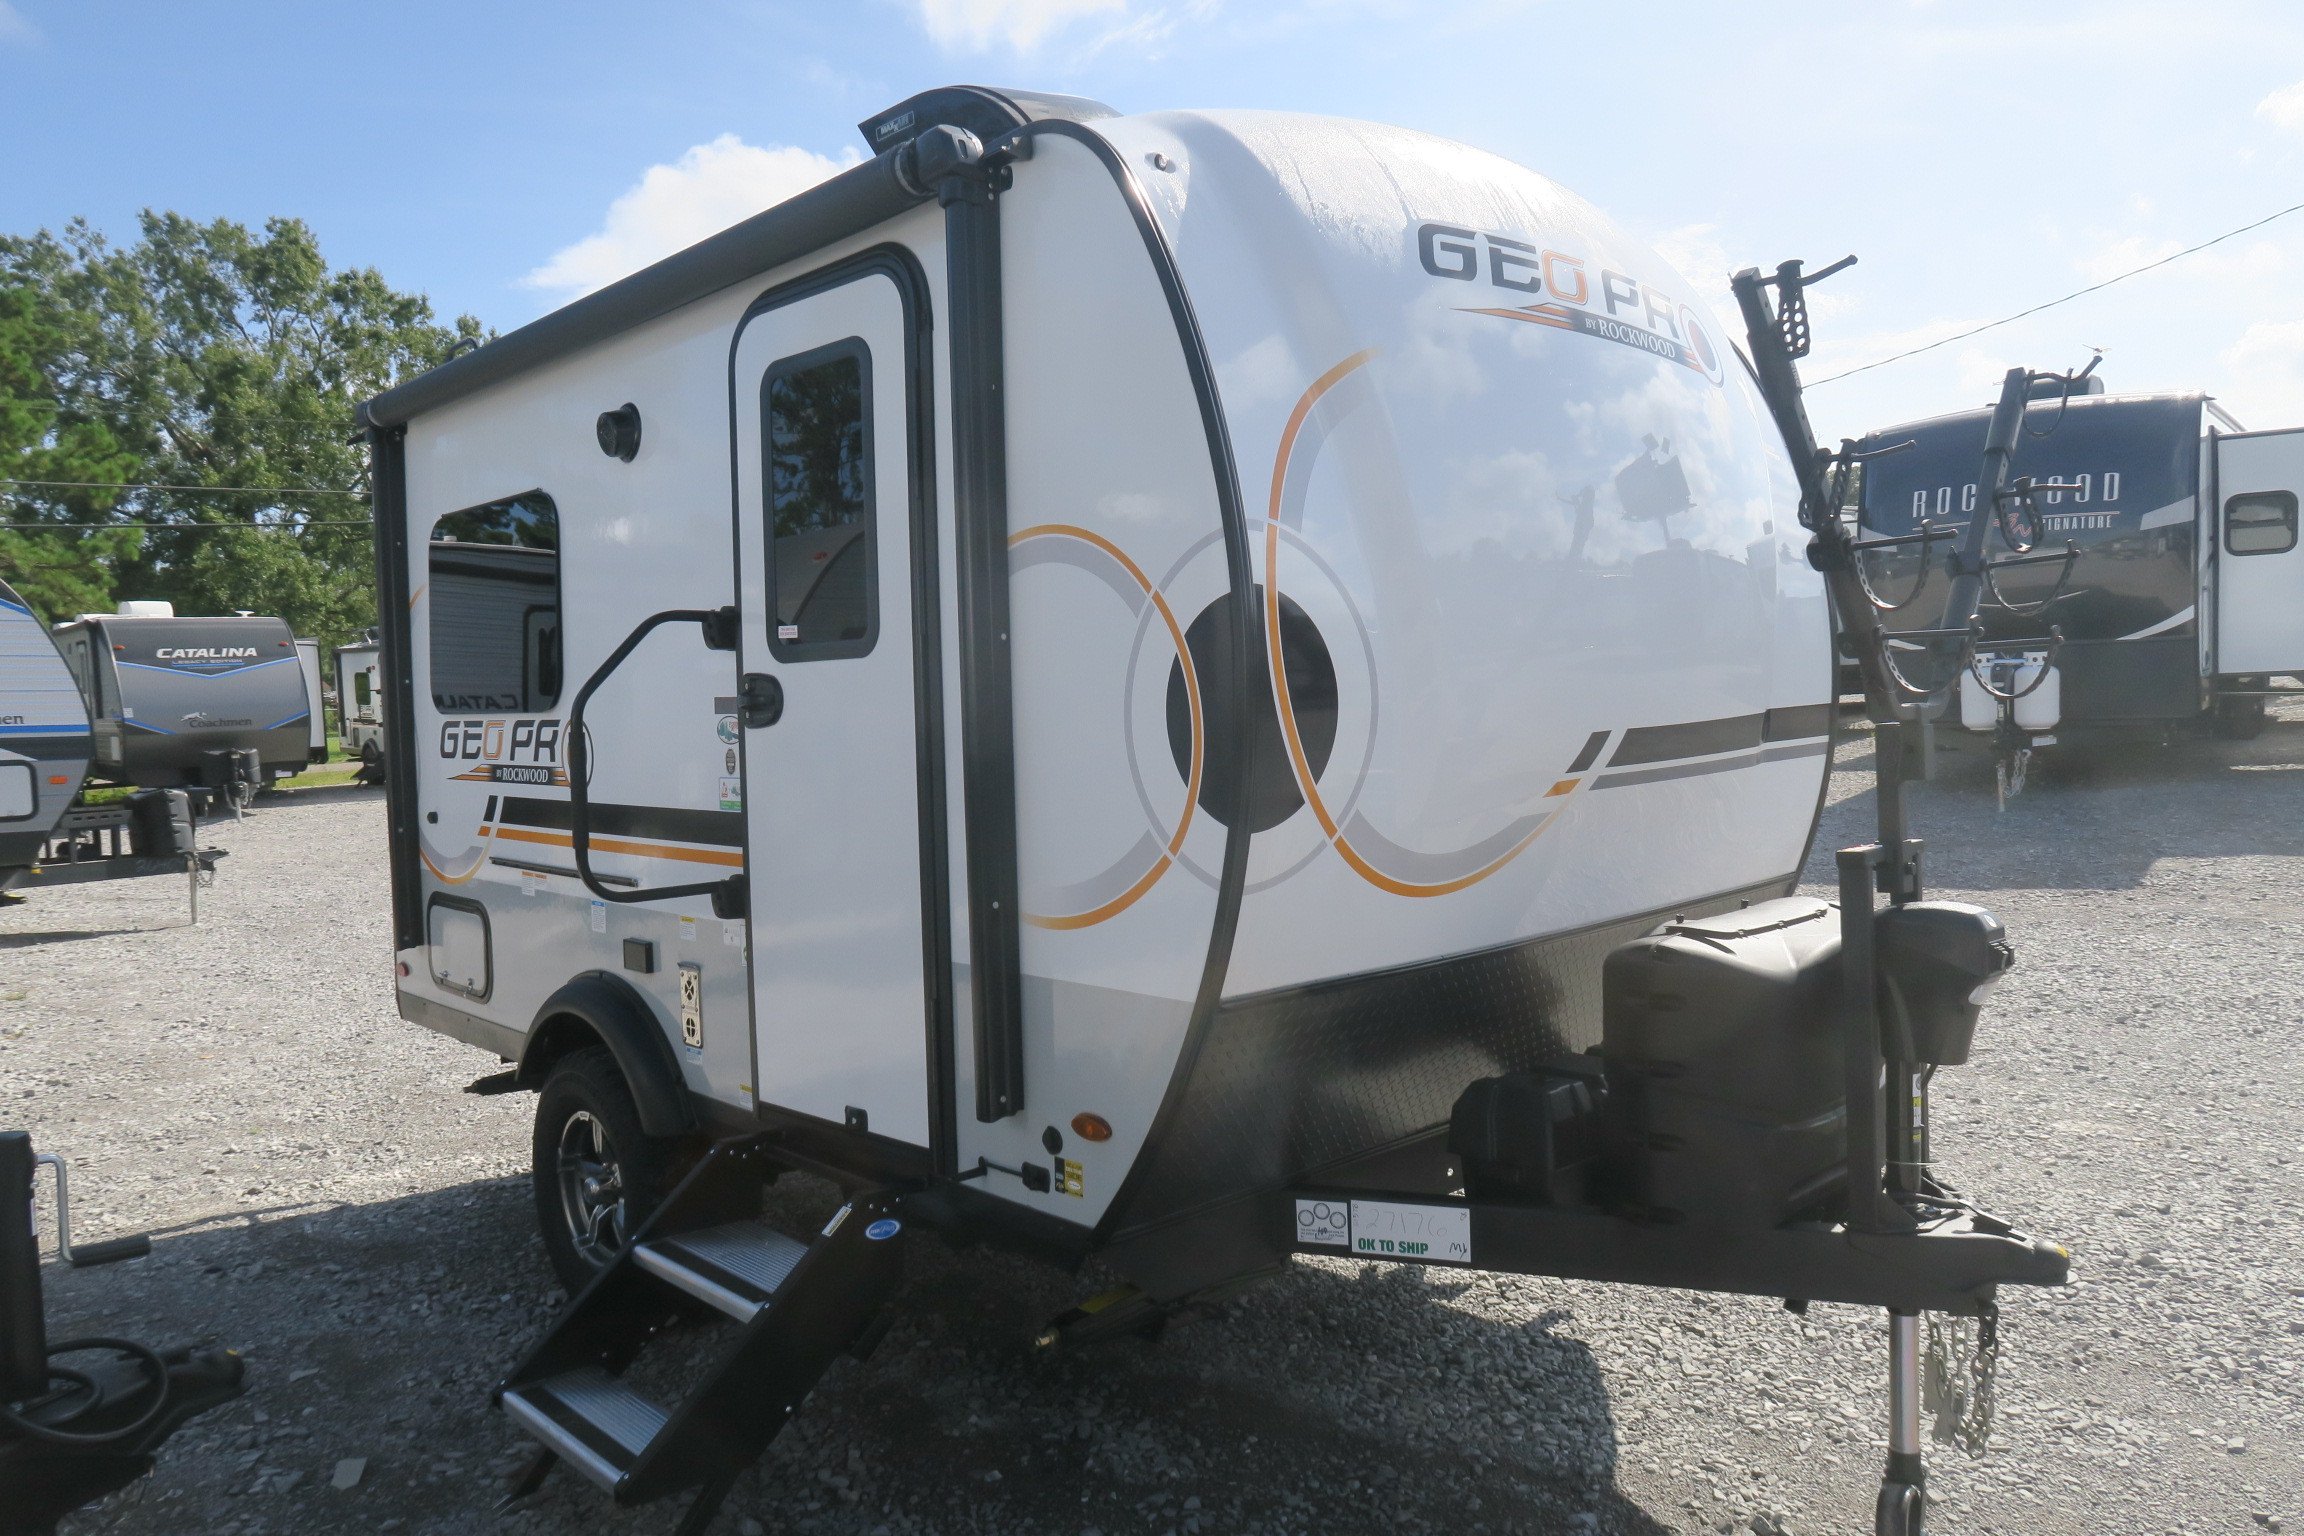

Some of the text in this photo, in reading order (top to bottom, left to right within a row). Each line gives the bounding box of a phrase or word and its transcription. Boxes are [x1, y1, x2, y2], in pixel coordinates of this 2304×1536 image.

[1418, 223, 1589, 305] GEO
[1585, 318, 1676, 358] BY ROCKWOOD
[2042, 515, 2112, 531] IGNATURE
[156, 647, 258, 659] CATALINA
[189, 718, 252, 728] Coachmen
[440, 719, 506, 760] GEO
[502, 767, 549, 783] ROCKWOOD
[1358, 1238, 1429, 1255] OK TO SHIP
